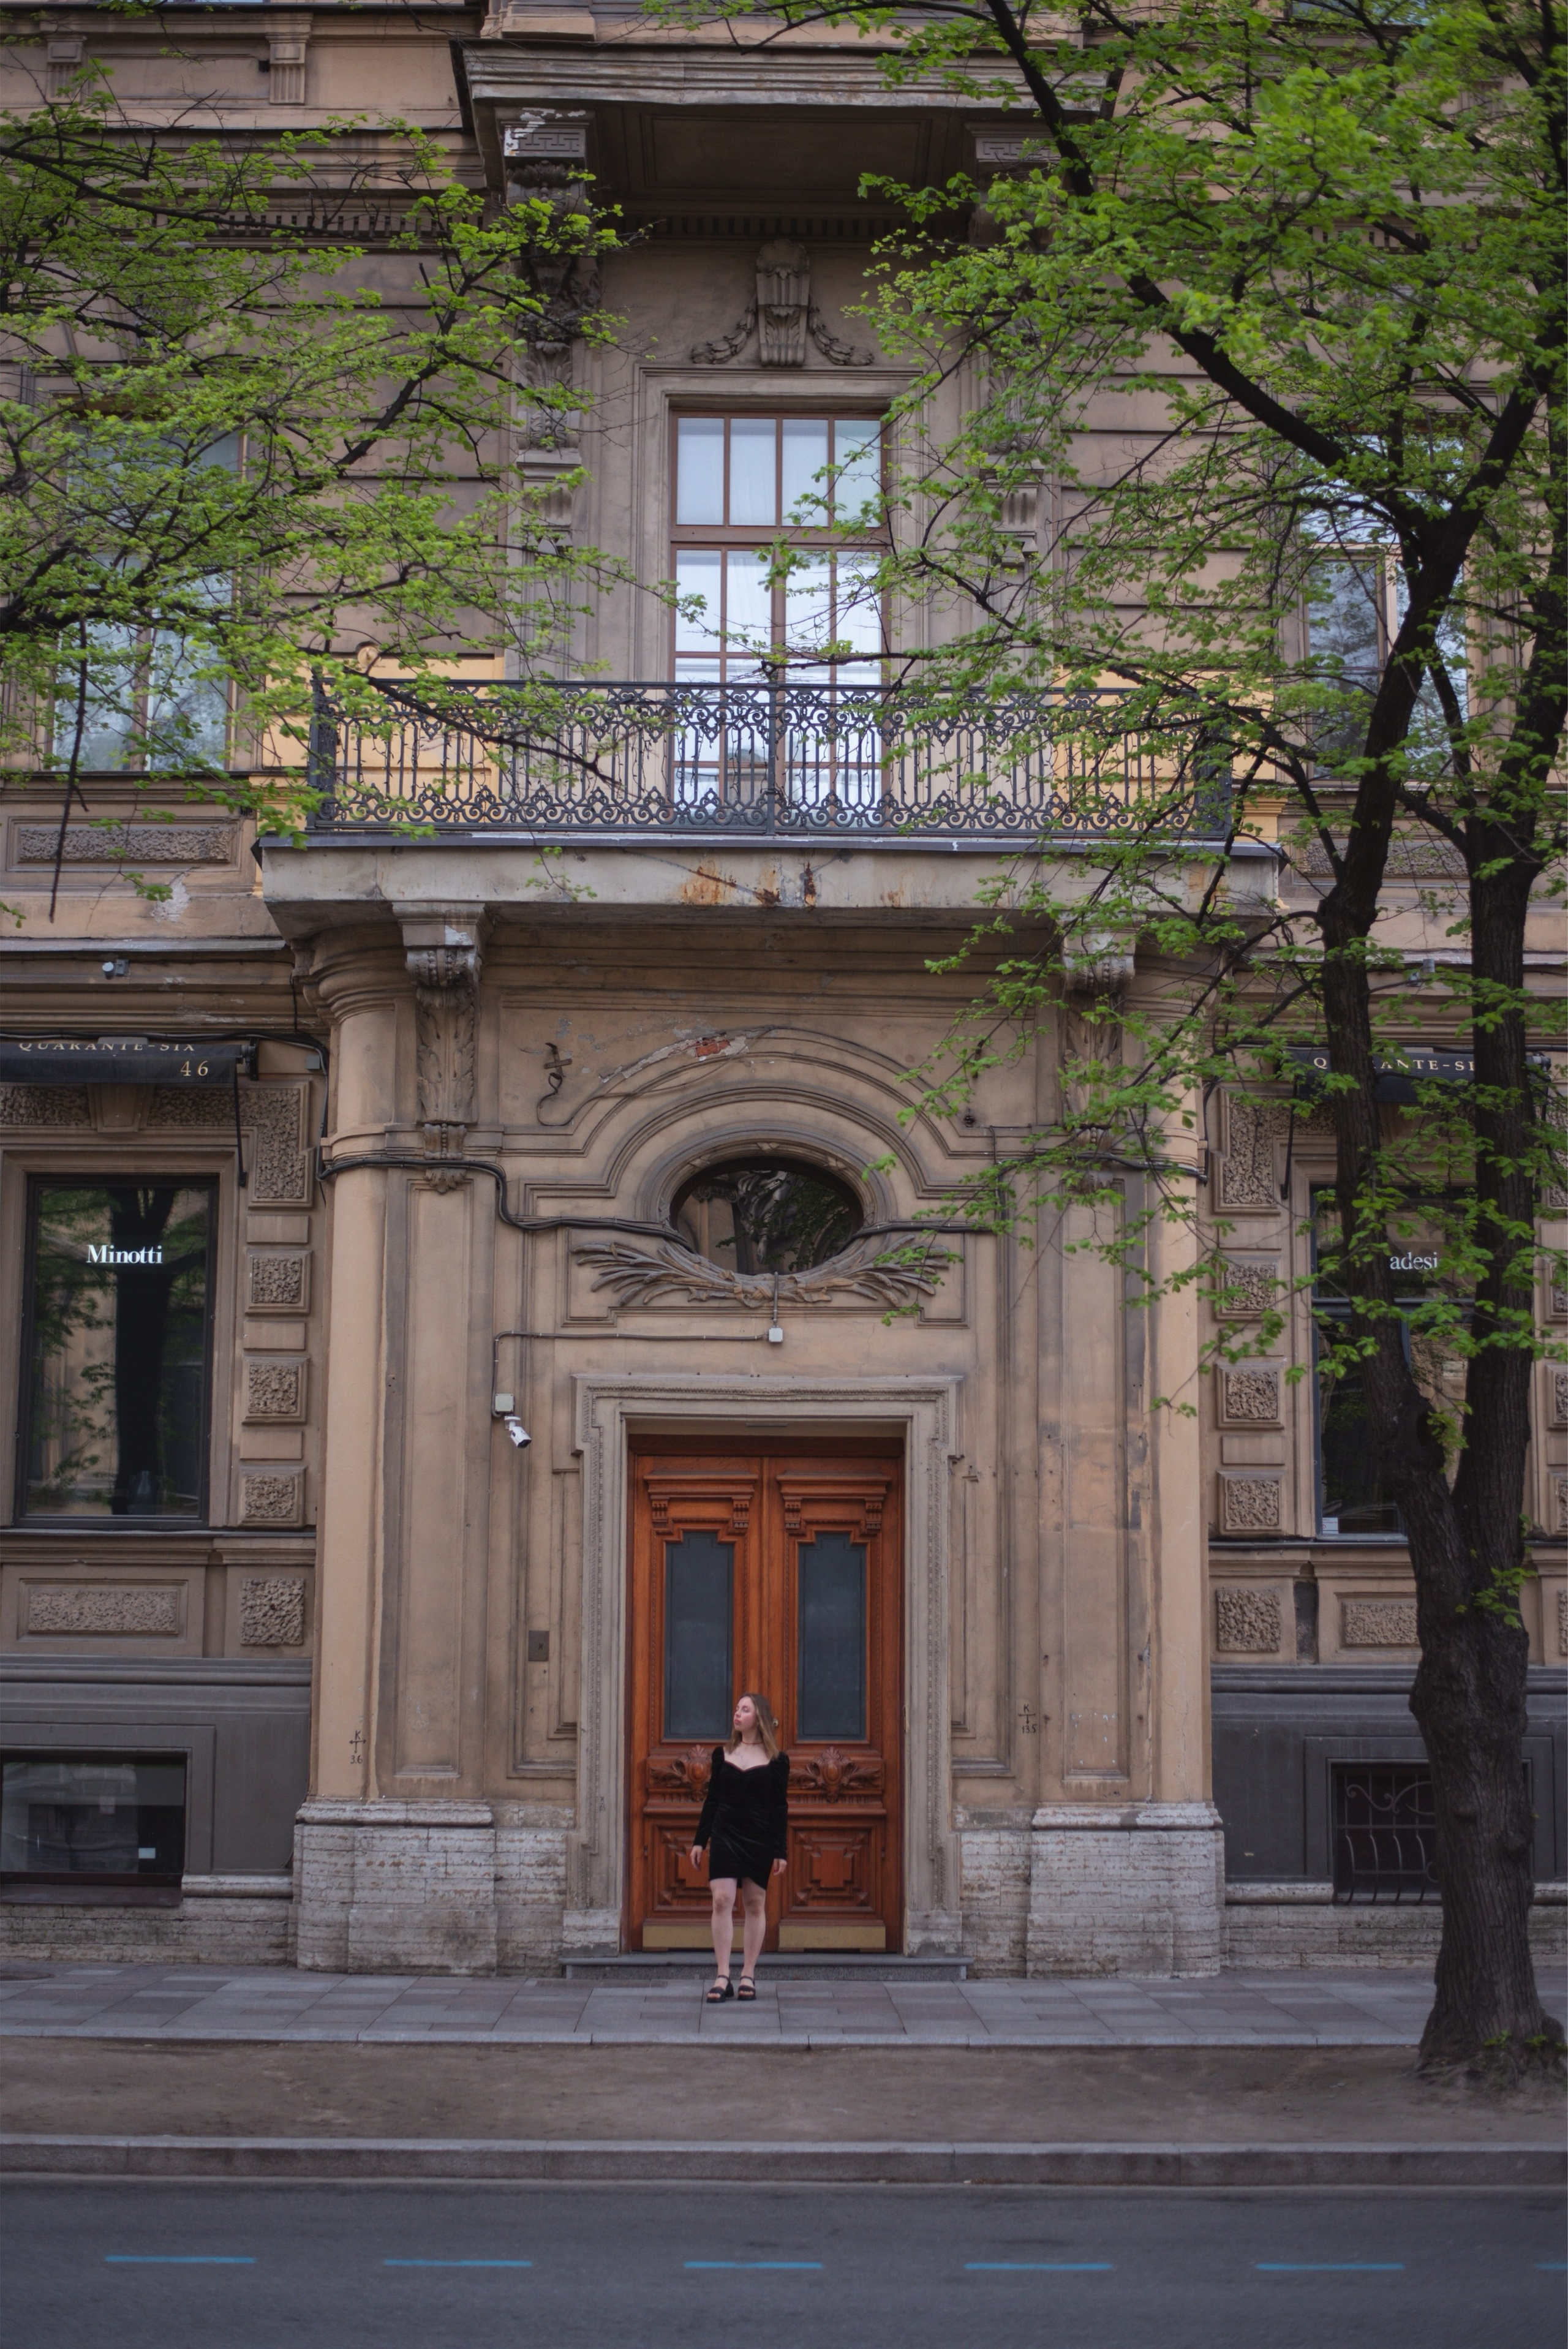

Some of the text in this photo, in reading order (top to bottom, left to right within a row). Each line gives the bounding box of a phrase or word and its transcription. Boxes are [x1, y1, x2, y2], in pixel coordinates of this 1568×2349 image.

[180, 1060, 208, 1077] 46
[86, 1244, 163, 1264] Minotti
[1389, 1251, 1441, 1270] adesi
[350, 1754, 363, 1764] 3.6
